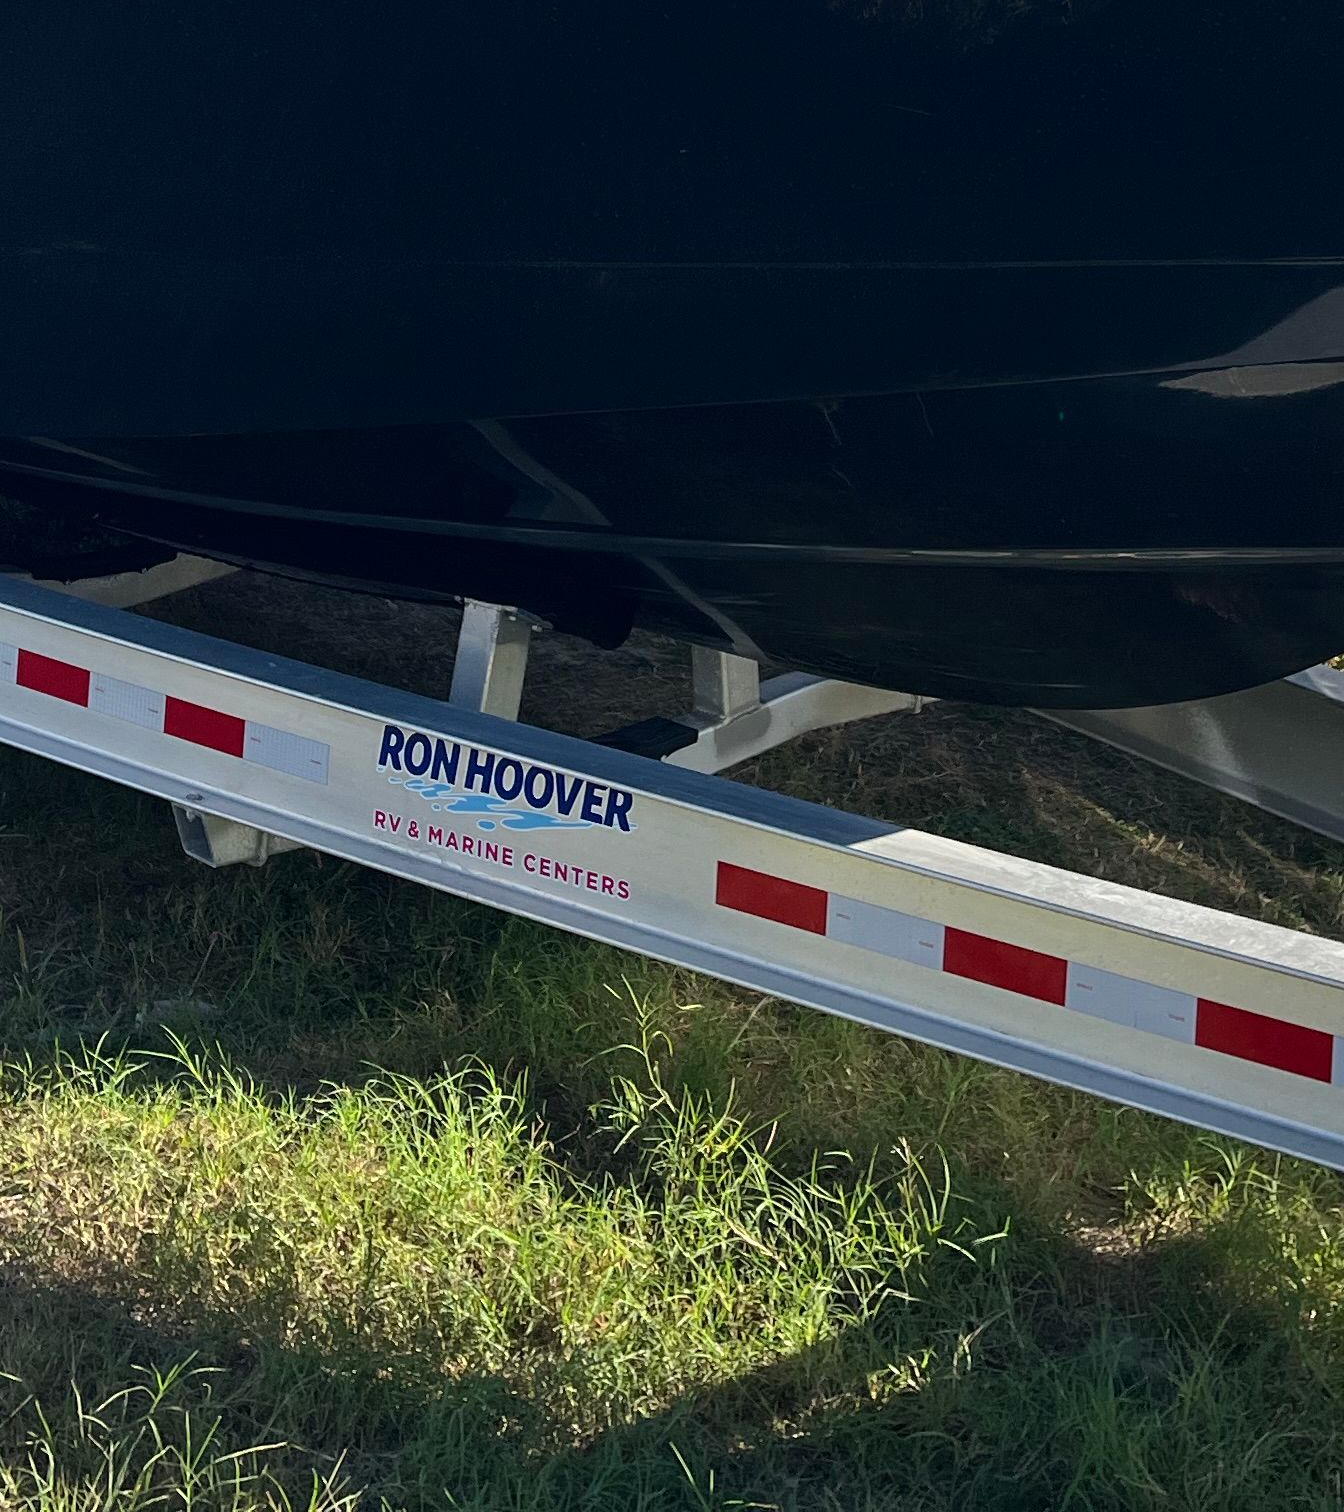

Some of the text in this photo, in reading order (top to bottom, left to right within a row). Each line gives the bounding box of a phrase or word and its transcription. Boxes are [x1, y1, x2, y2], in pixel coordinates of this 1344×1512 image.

[378, 724, 634, 832] RON HOOVER
[374, 810, 630, 900] RV & MARINE CENTERS
